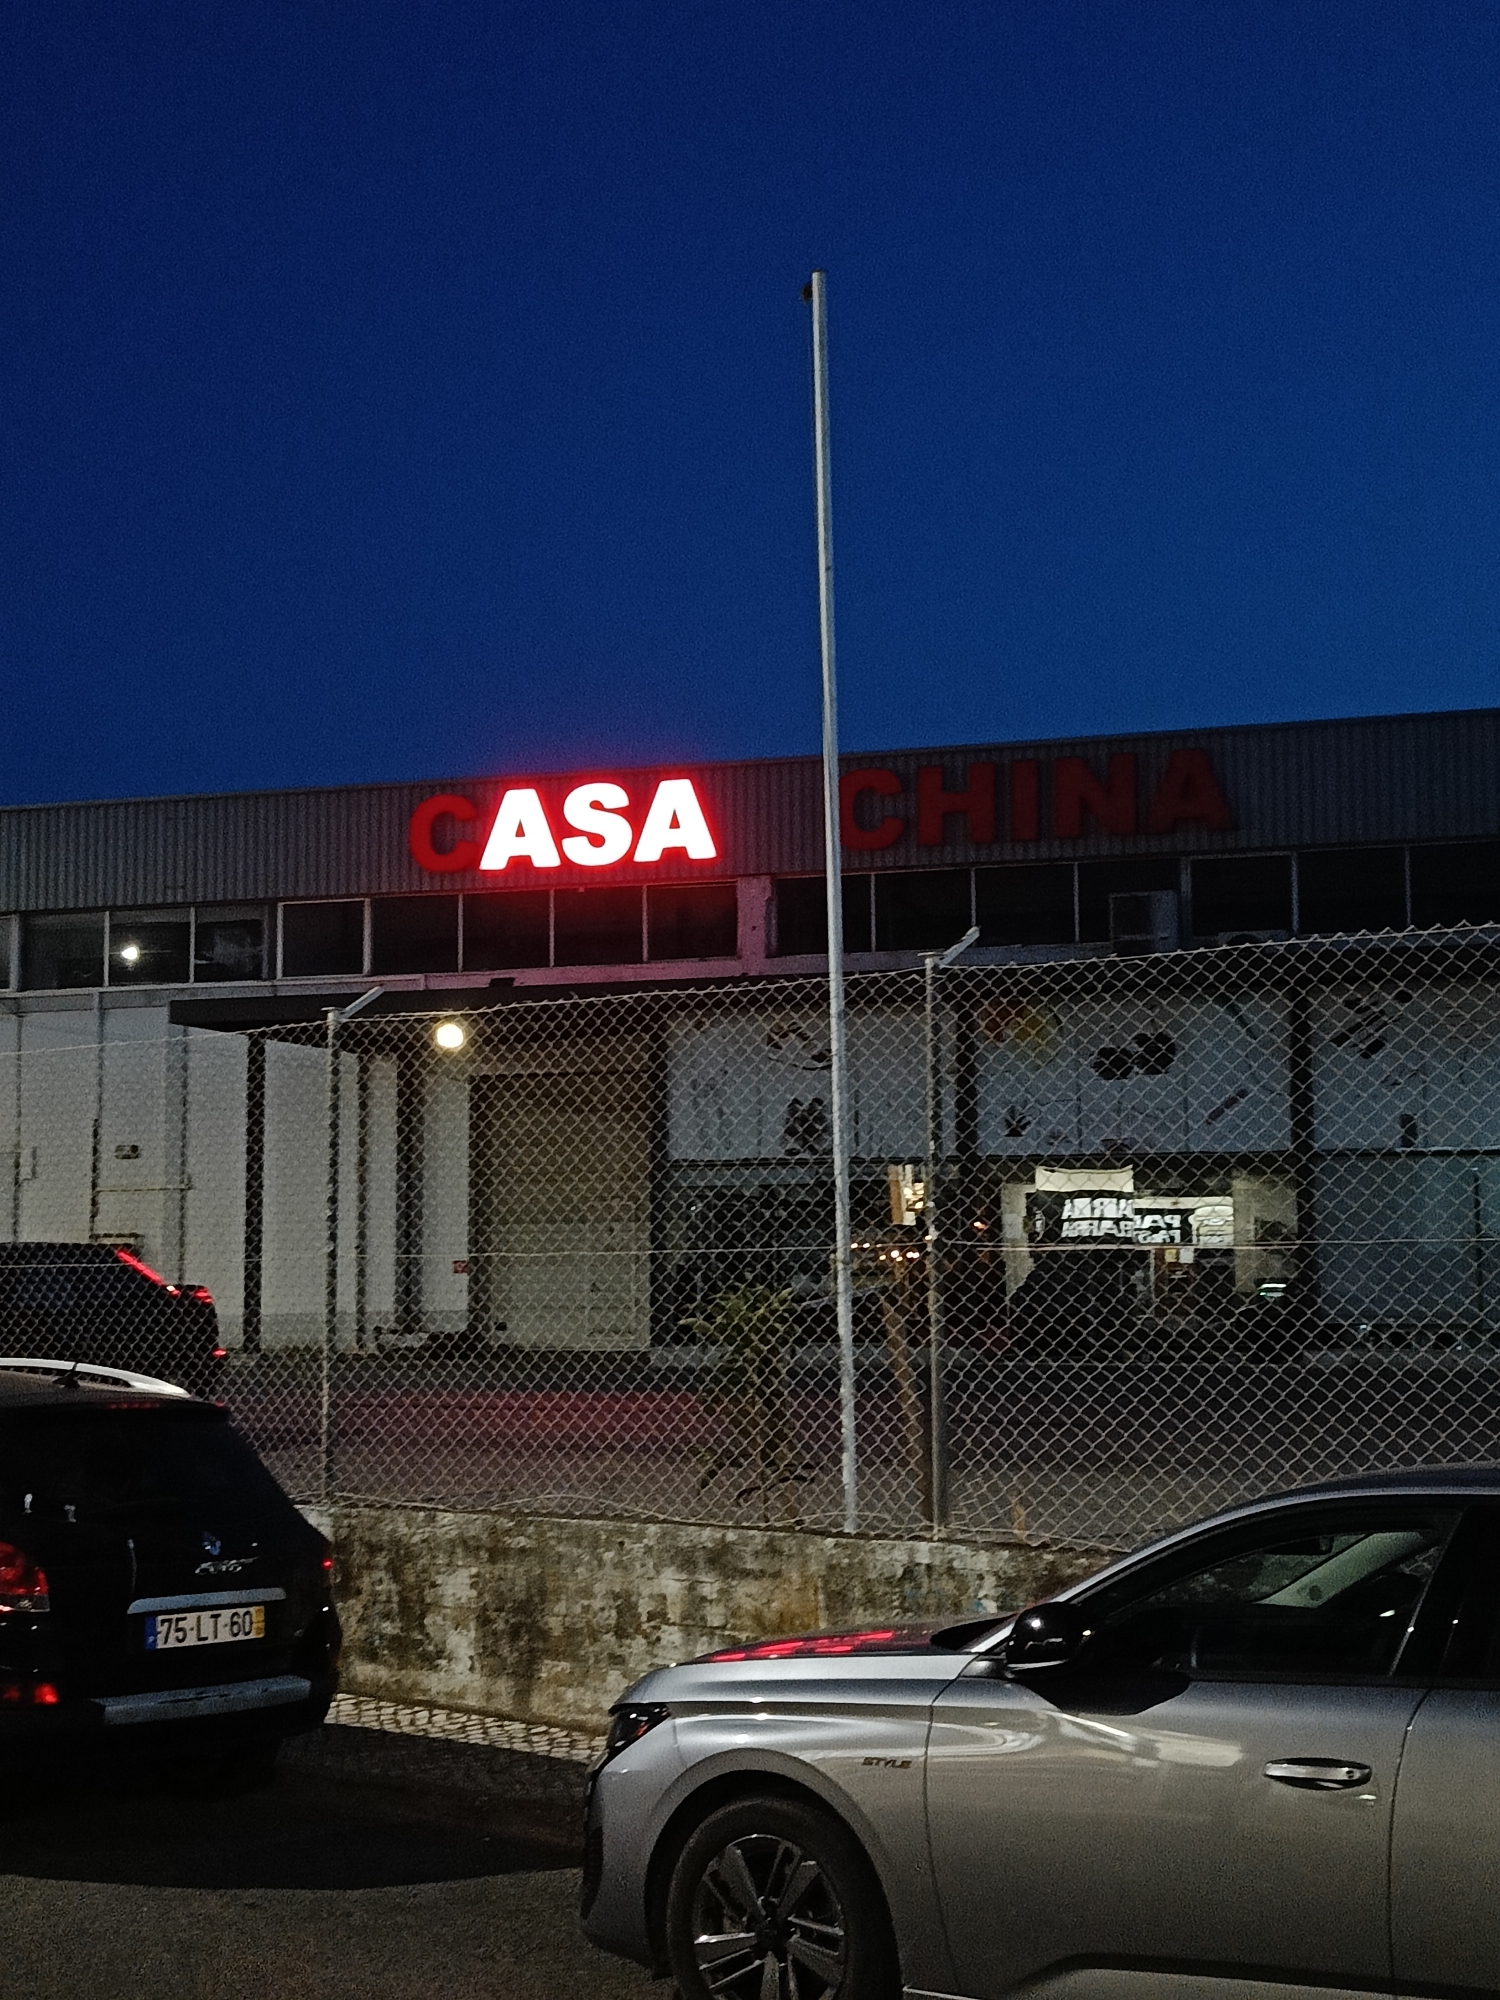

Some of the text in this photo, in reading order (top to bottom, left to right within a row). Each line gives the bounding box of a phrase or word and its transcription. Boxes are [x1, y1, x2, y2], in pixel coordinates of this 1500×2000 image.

[408, 748, 1233, 872] CASA CHINA
[861, 1756, 912, 1769] STYLE
